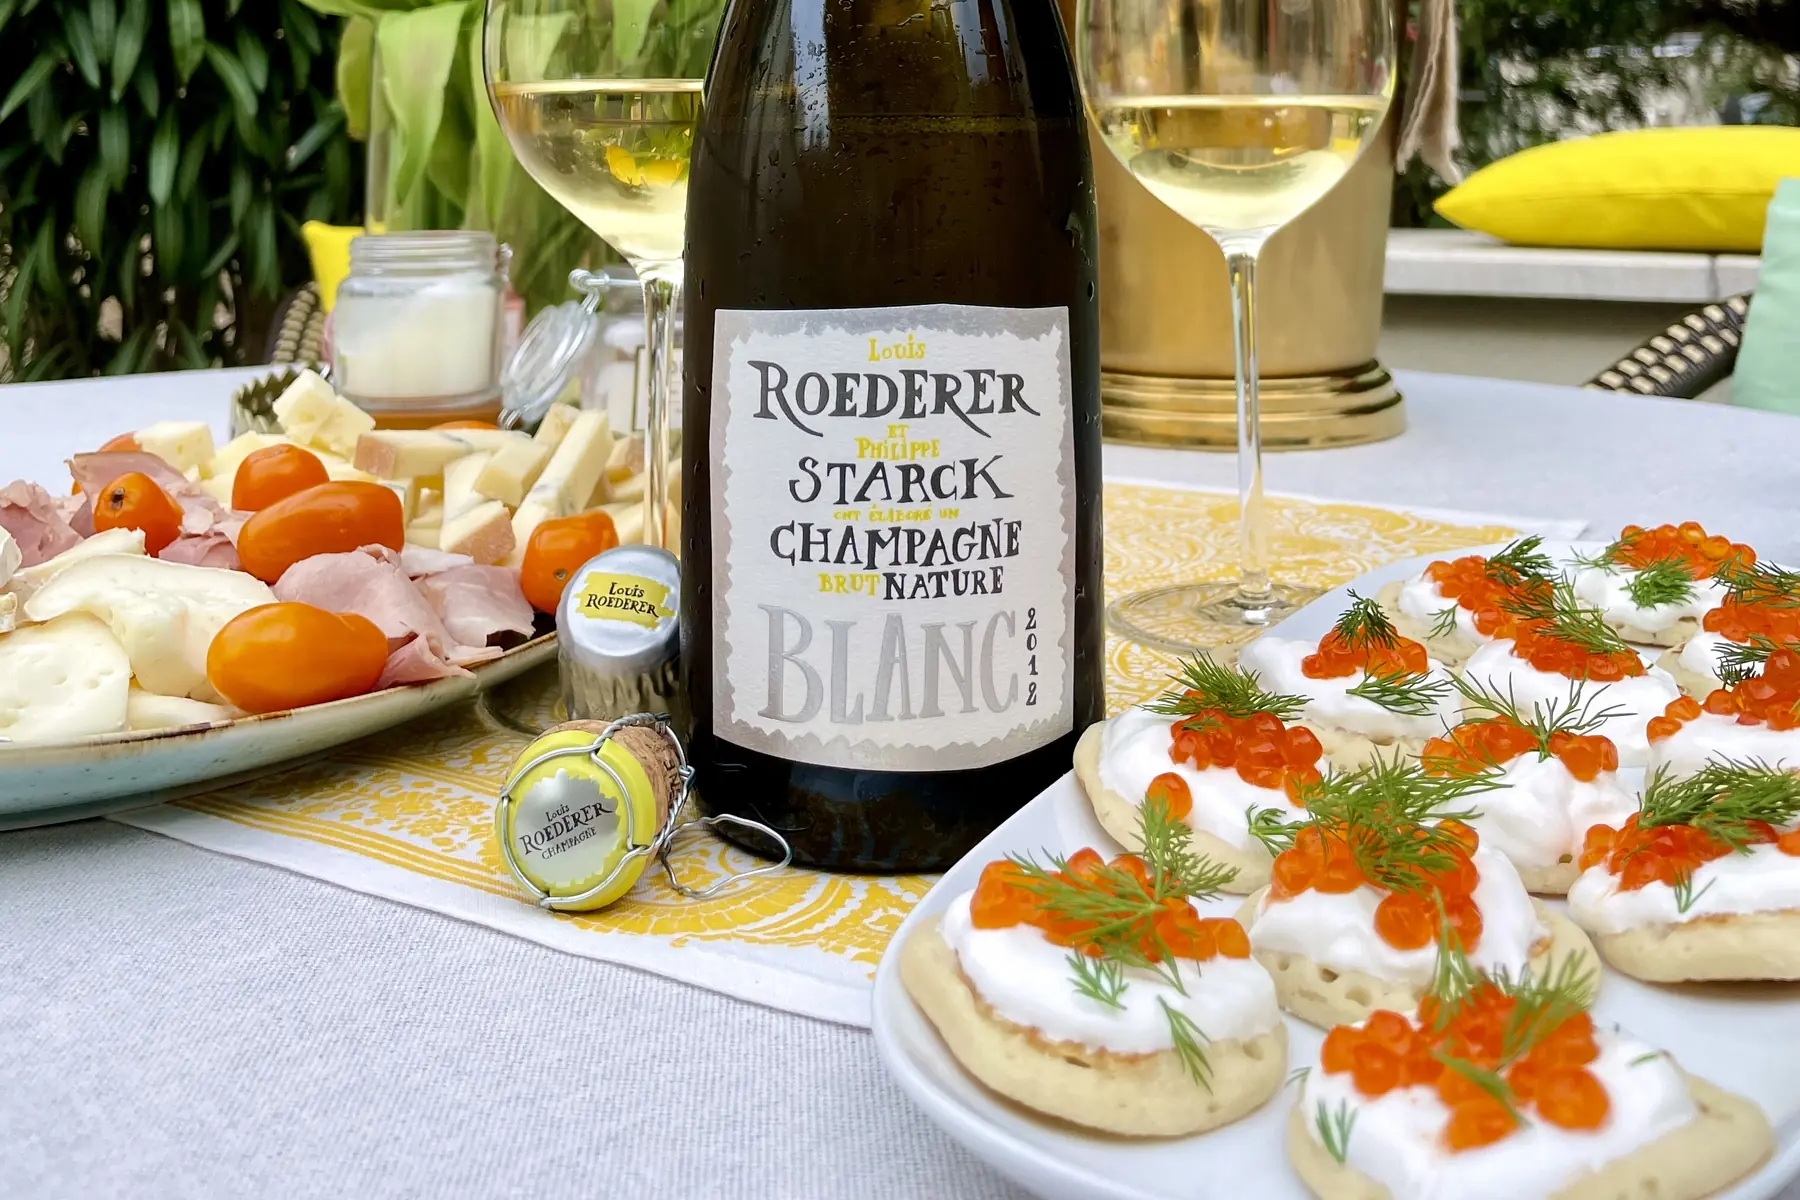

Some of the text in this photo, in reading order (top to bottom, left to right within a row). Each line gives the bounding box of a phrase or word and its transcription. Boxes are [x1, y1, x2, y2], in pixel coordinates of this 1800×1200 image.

[867, 333, 926, 362] Louis
[747, 360, 1041, 438] ROEDERER
[887, 424, 910, 438] ET
[788, 455, 1014, 505] STARCK
[769, 517, 1022, 571] CHAMPAGNE
[608, 581, 645, 598] Louis
[817, 565, 1004, 600] BRUT NATURE
[585, 593, 660, 618] ROEDERER
[757, 603, 1019, 725] BLANC
[1025, 607, 1039, 706] 2012
[519, 802, 613, 855] ROEDERER
[545, 803, 570, 822] Louis
[541, 826, 597, 860] CHAMPAGNE
